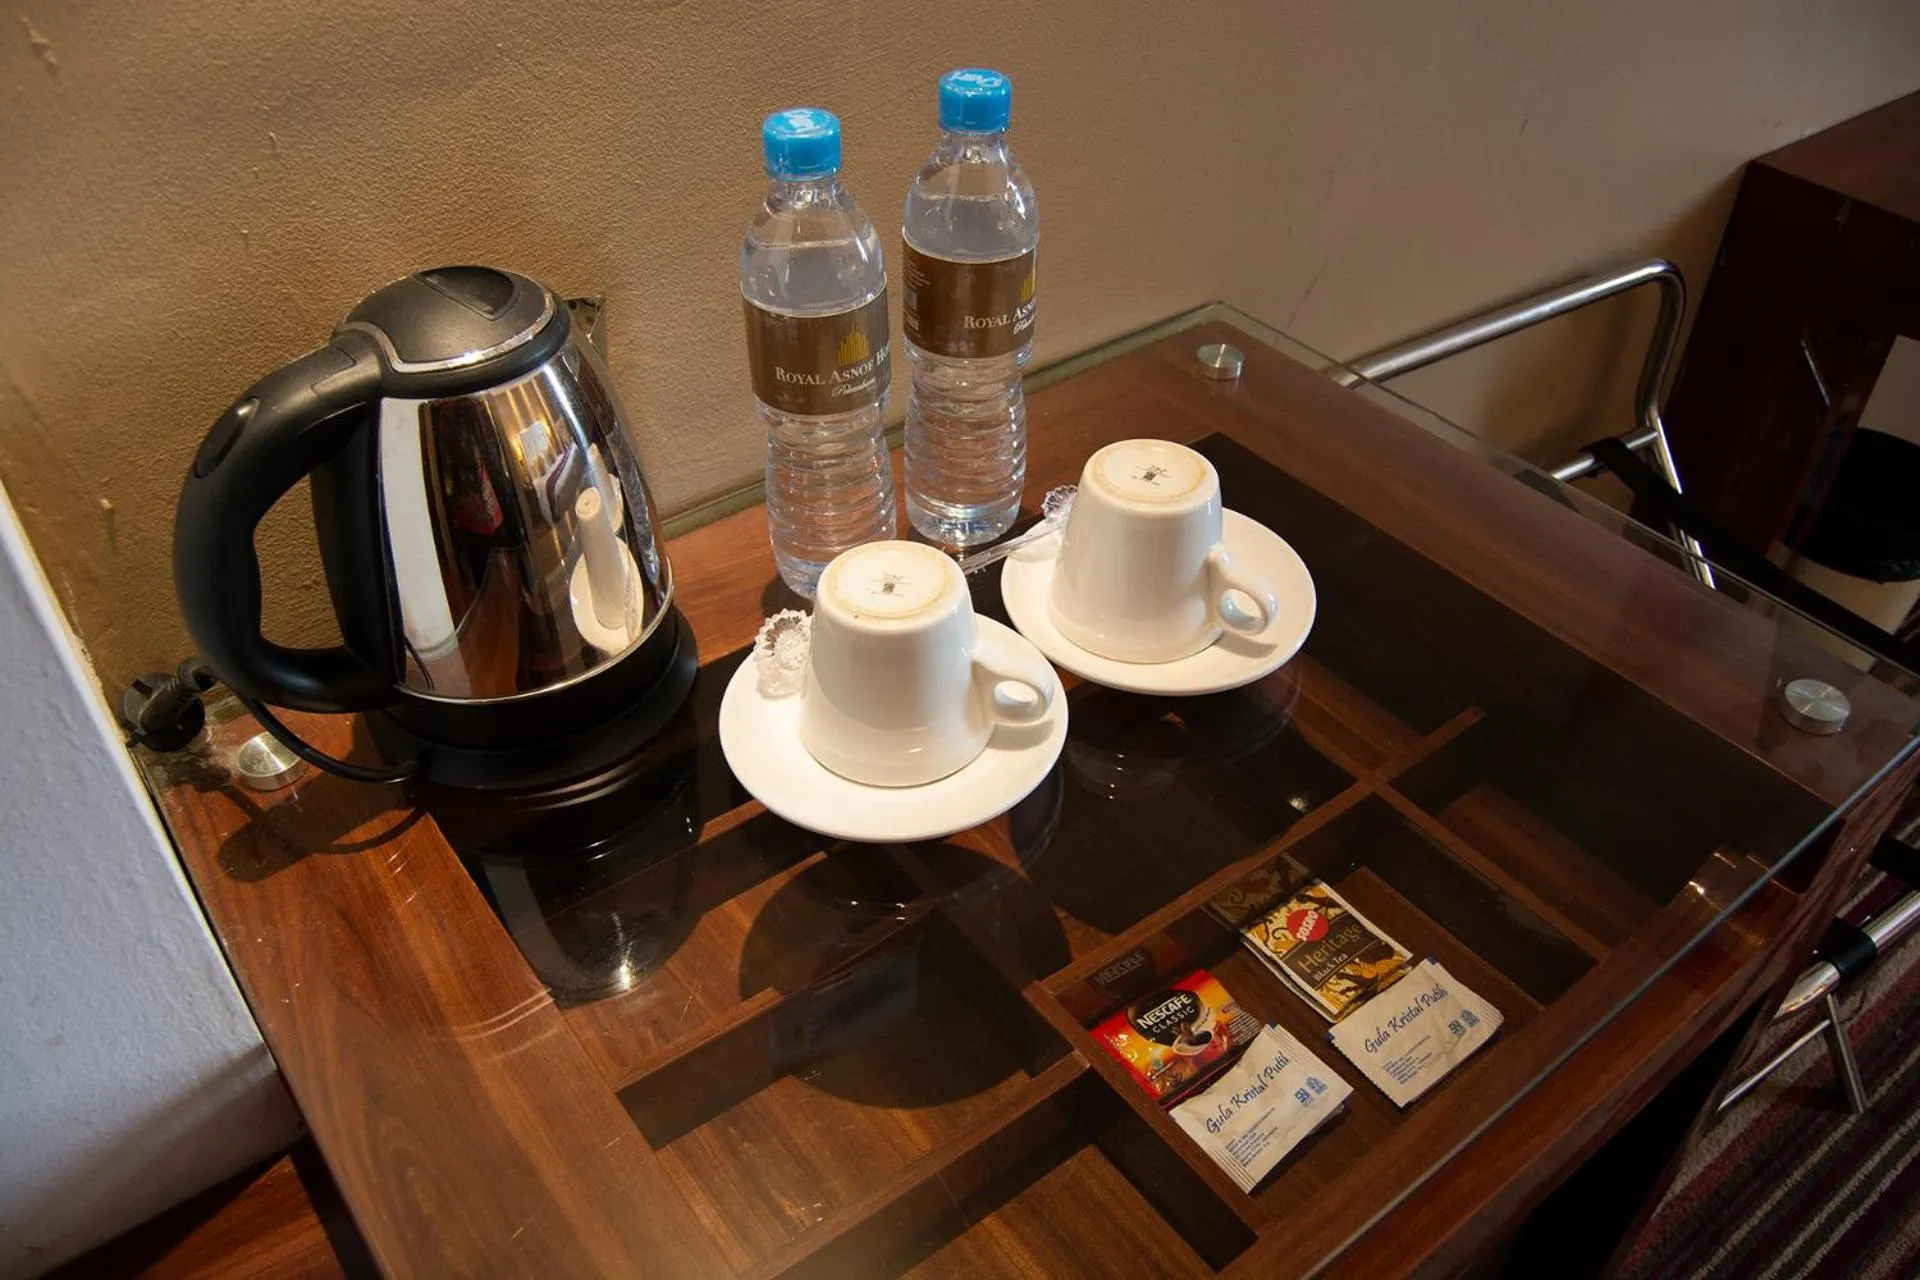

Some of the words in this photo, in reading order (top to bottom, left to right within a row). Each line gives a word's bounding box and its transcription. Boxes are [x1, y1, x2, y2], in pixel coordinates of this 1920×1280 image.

[963, 314, 1011, 330] ROYAL
[774, 366, 826, 386] ROYAL
[828, 358, 875, 385] ASNOF
[1295, 909, 1319, 942] SOSRO
[1297, 923, 1361, 974] Heritage
[1152, 1006, 1196, 1034] CLASSIC
[1364, 1026, 1391, 1054] Gula
[1388, 999, 1425, 1033] Kristal
[1206, 1104, 1233, 1134] Gula
[1230, 1074, 1268, 1112] Kristal
